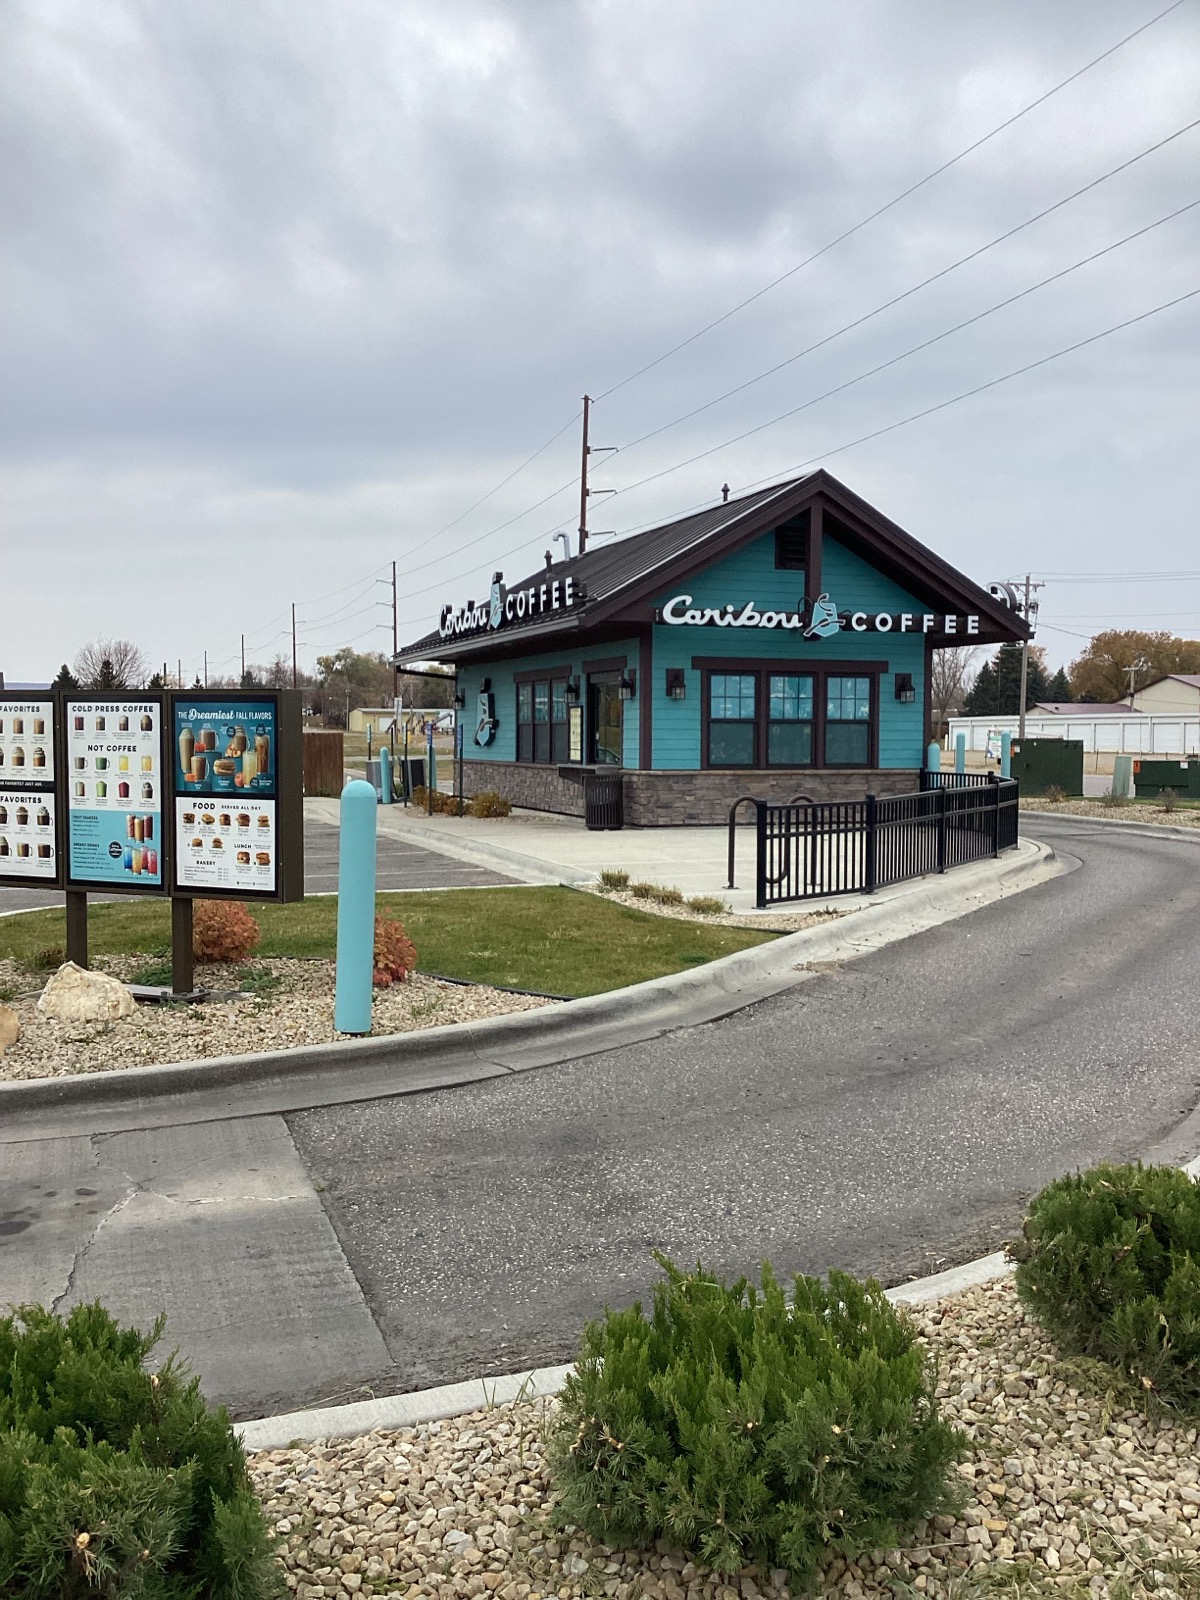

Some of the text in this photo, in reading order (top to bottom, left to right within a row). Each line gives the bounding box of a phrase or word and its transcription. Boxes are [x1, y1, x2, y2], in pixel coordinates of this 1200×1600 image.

[438, 576, 573, 637] Caribou COFFEE
[662, 594, 979, 634] Caribou COFFEE
[188, 709, 235, 720] Dreamiest
